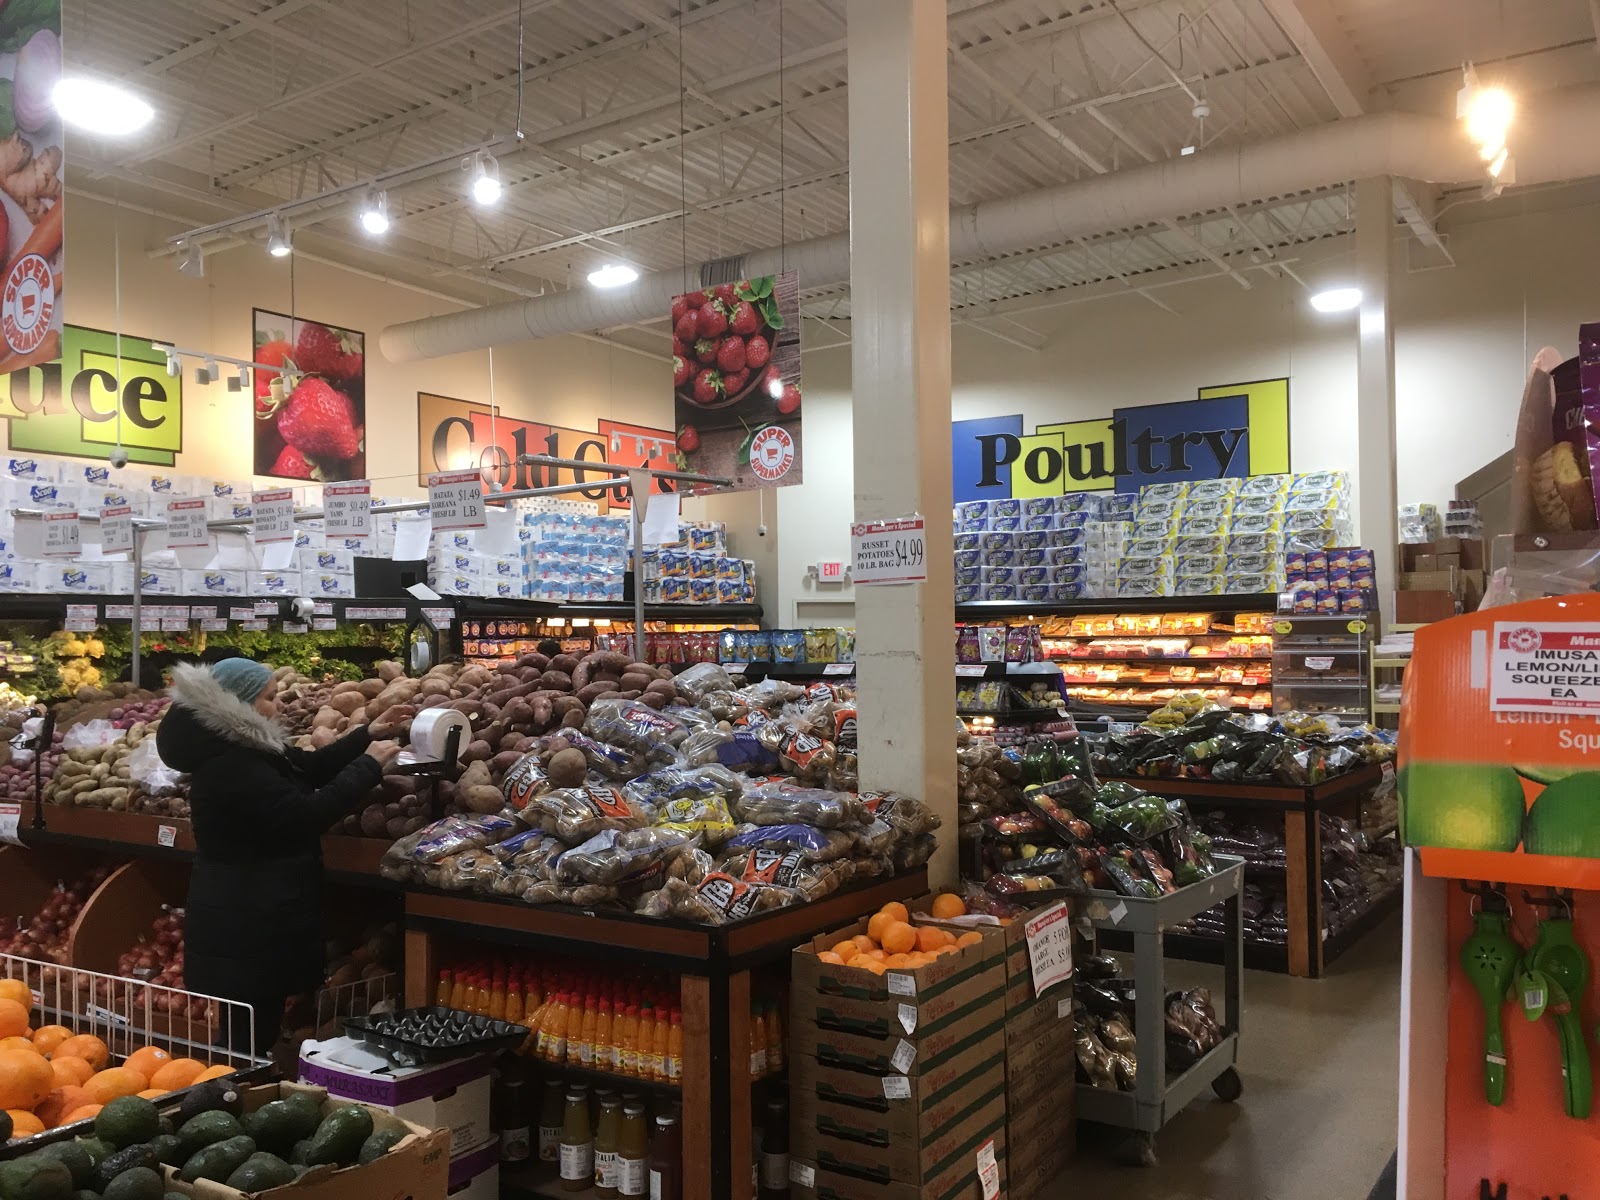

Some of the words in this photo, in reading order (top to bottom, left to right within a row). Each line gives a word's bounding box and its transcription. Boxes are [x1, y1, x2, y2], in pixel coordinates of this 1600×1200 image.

[6, 257, 50, 303] SUPER
[3, 302, 53, 350] SUPERMARKET
[752, 427, 791, 452] SUPER
[433, 416, 560, 492] Cold
[975, 418, 1248, 488] Poultry
[751, 453, 793, 480] SUPERMARKET
[434, 491, 453, 499] BATATA
[458, 489, 480, 501] $1.49
[350, 501, 368, 512] $0.49
[432, 501, 457, 509] KOREANA
[277, 505, 292, 518] $1.99
[433, 510, 448, 519] FRESH
[463, 506, 477, 517] LB
[280, 521, 288, 531] LB
[352, 516, 363, 527] LB
[193, 528, 202, 538] LB
[862, 541, 889, 549] RUSSET
[858, 550, 894, 560] POTATOES
[896, 539, 923, 568] $4.99
[824, 563, 840, 576] EXIT
[879, 560, 894, 568] BAG
[1535, 650, 1598, 660] IMUSA
[1505, 662, 1600, 673] LEMON/LI
[1551, 688, 1577, 698] EA
[1033, 934, 1050, 953] ORANGE
[1035, 947, 1049, 964] LARGE
[542, 1128, 561, 1137] VITAL
[595, 1154, 616, 1162] ITALIA
